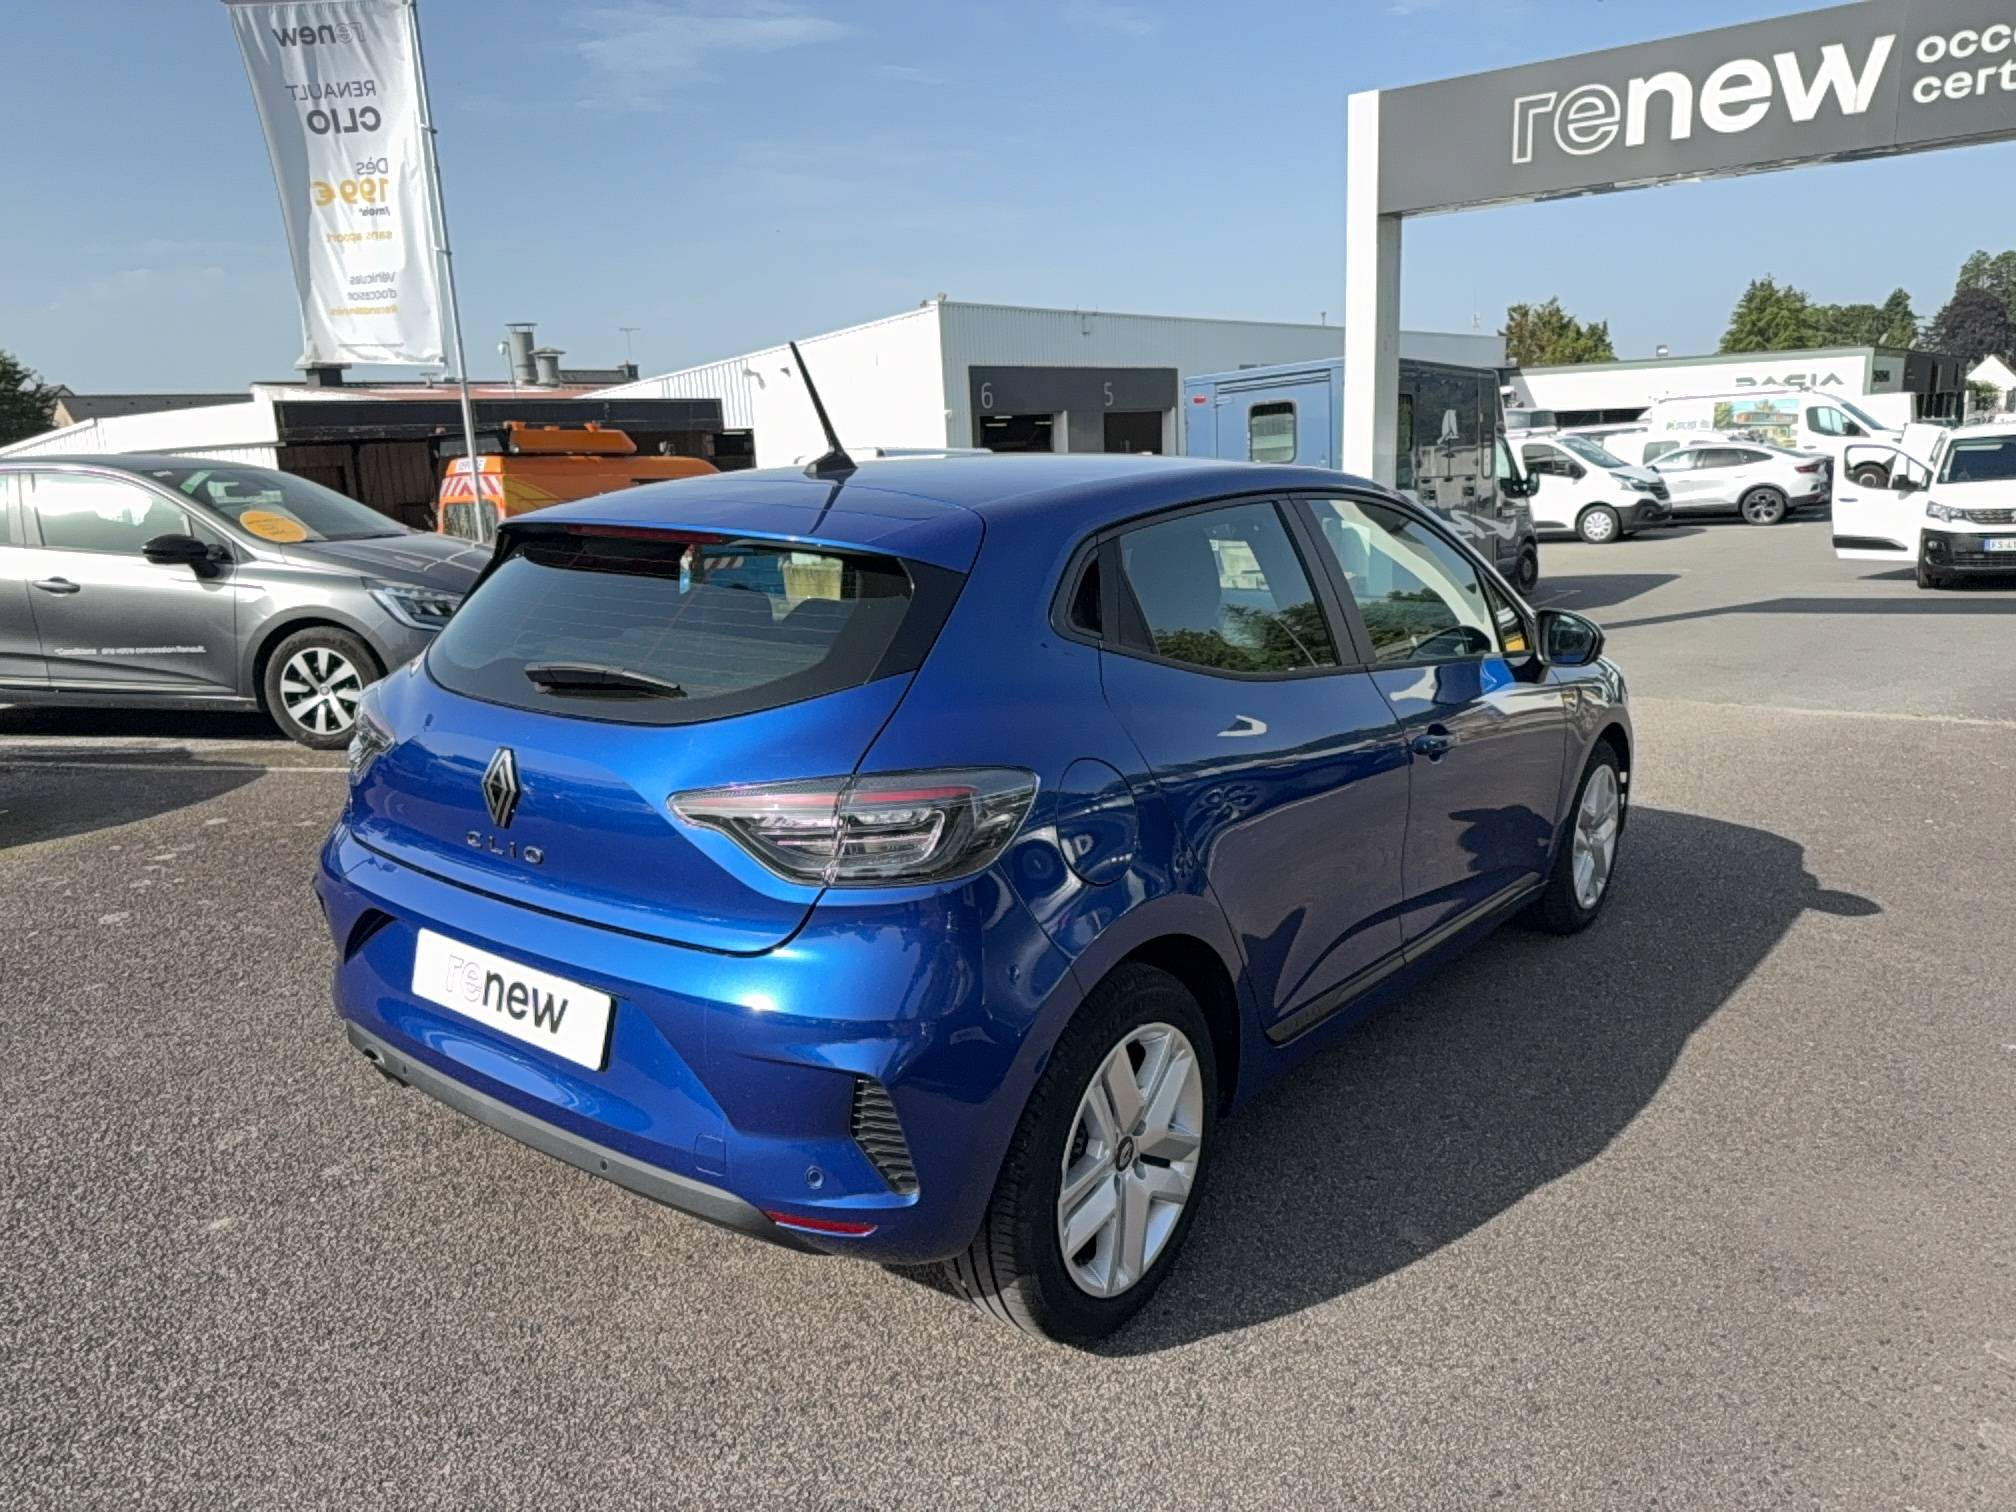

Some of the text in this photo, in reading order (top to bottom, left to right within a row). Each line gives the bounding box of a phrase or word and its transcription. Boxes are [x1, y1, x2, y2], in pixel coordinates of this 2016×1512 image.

[1916, 23, 2016, 63] occ
[1511, 33, 1896, 164] renew
[980, 381, 1114, 408] 6 5
[1735, 372, 1846, 388] DACIA
[466, 830, 544, 864] CLIO
[447, 955, 568, 1033] renew
